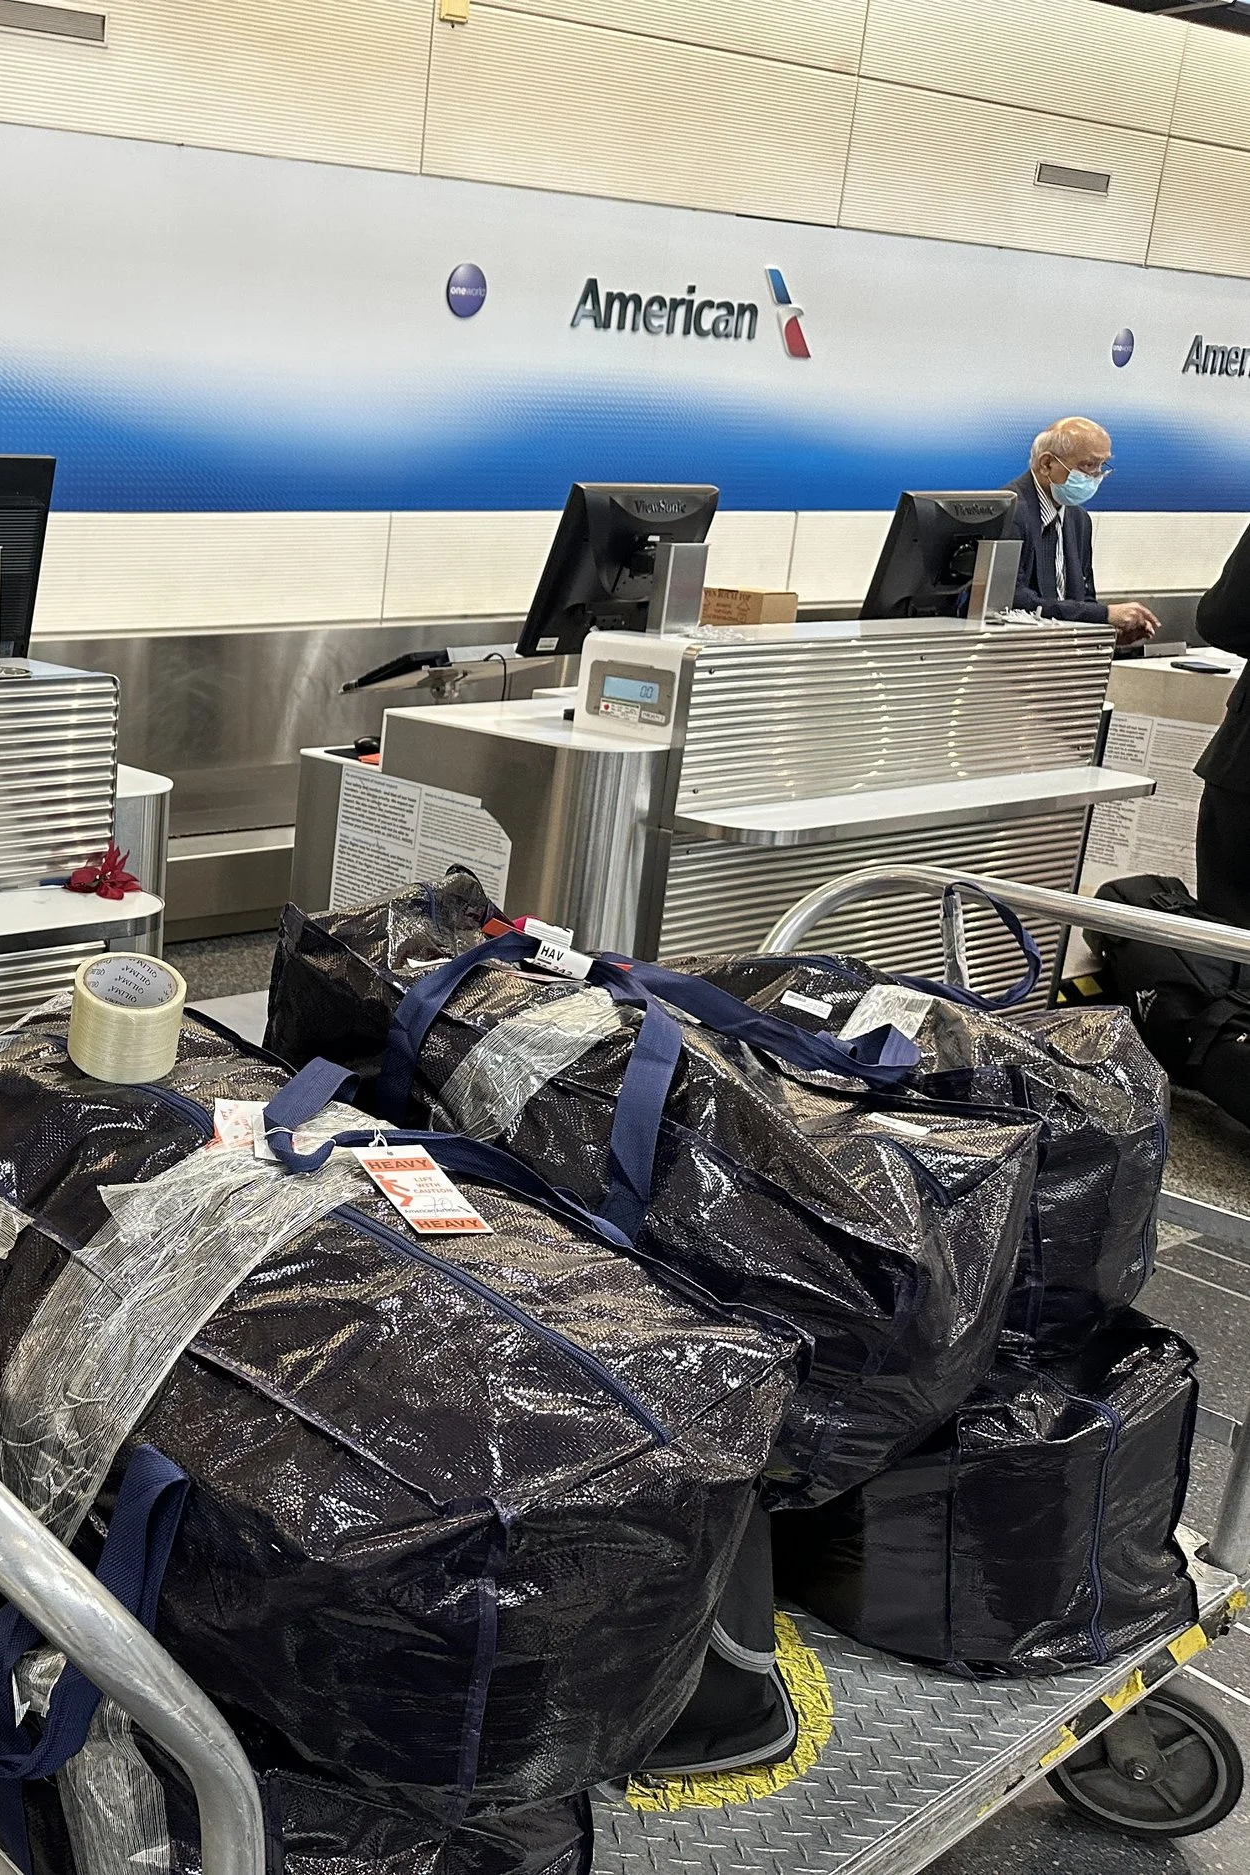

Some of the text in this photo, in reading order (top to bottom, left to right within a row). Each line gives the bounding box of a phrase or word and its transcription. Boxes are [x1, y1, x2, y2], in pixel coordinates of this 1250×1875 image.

[570, 277, 758, 341] American
[1181, 334, 1250, 378] Amer
[635, 499, 687, 514] ViewSonic
[541, 946, 564, 961] HAV
[367, 1159, 429, 1170] HEAVY
[415, 1219, 479, 1229] HEAVY
